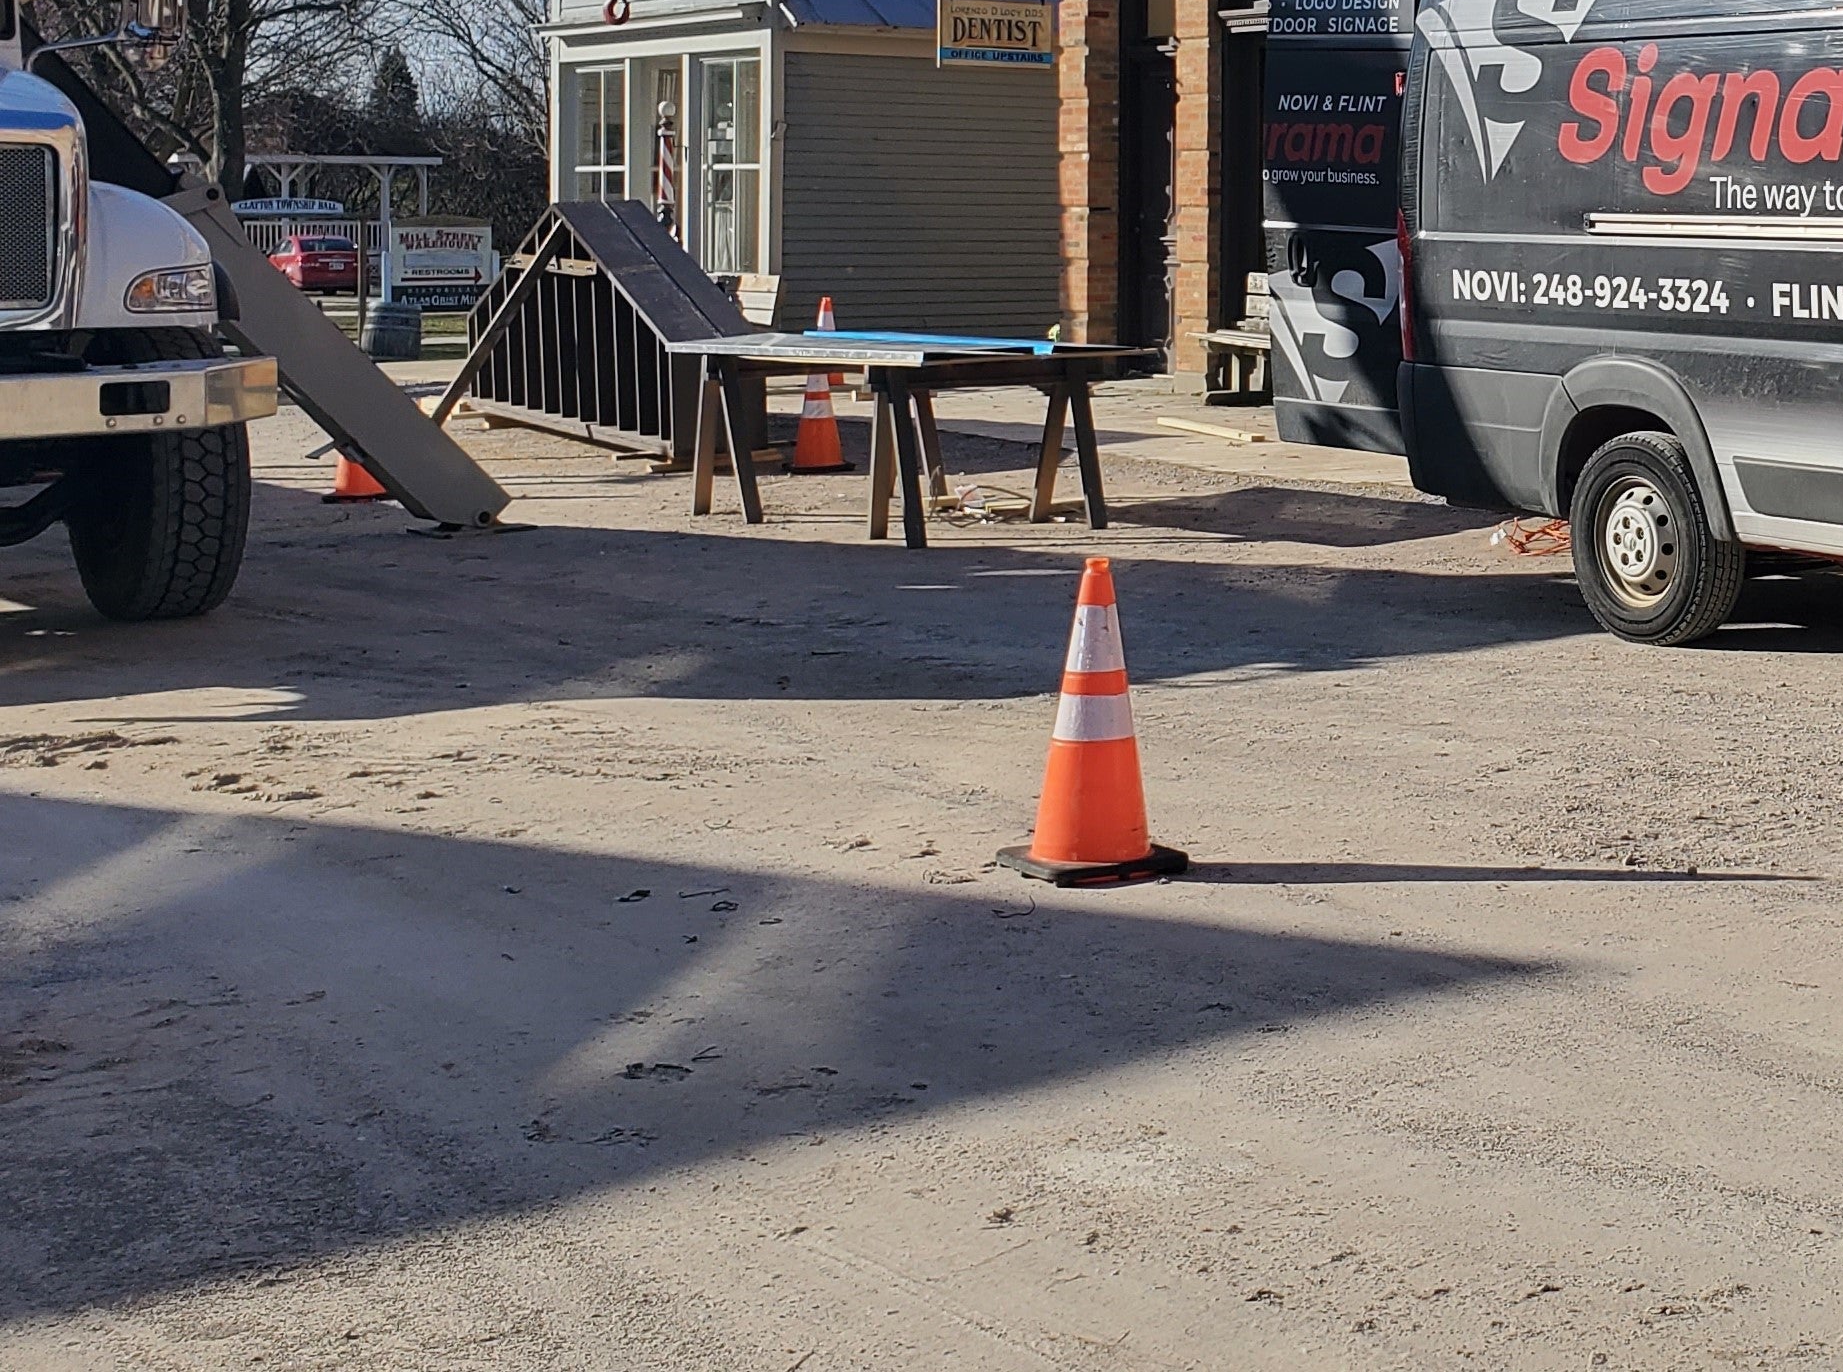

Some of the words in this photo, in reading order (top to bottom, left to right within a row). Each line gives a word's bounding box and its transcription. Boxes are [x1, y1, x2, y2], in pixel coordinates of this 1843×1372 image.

[952, 16, 1044, 47] DENTIST
[1328, 16, 1399, 32] SIGNAGE
[951, 50, 986, 59] OFFICE
[993, 52, 1044, 62] UPSTAIRS
[1278, 94, 1319, 111] NOVI
[1323, 95, 1333, 111] &
[1338, 95, 1387, 112] FLINT
[1271, 169, 1301, 184] grow
[1301, 169, 1326, 184] your
[1327, 167, 1380, 185] business.
[239, 200, 274, 210] CLAYTON
[276, 199, 316, 209] TOWNSHIP
[319, 201, 337, 210] HALL
[1709, 176, 1757, 210] The
[1763, 186, 1816, 217] way
[436, 229, 484, 244] STREET
[405, 239, 479, 251] WAREHOUSE
[411, 268, 470, 276] RESTROOMS
[1452, 268, 1527, 303] NOVI:
[1532, 272, 1730, 314] 248-924-3324
